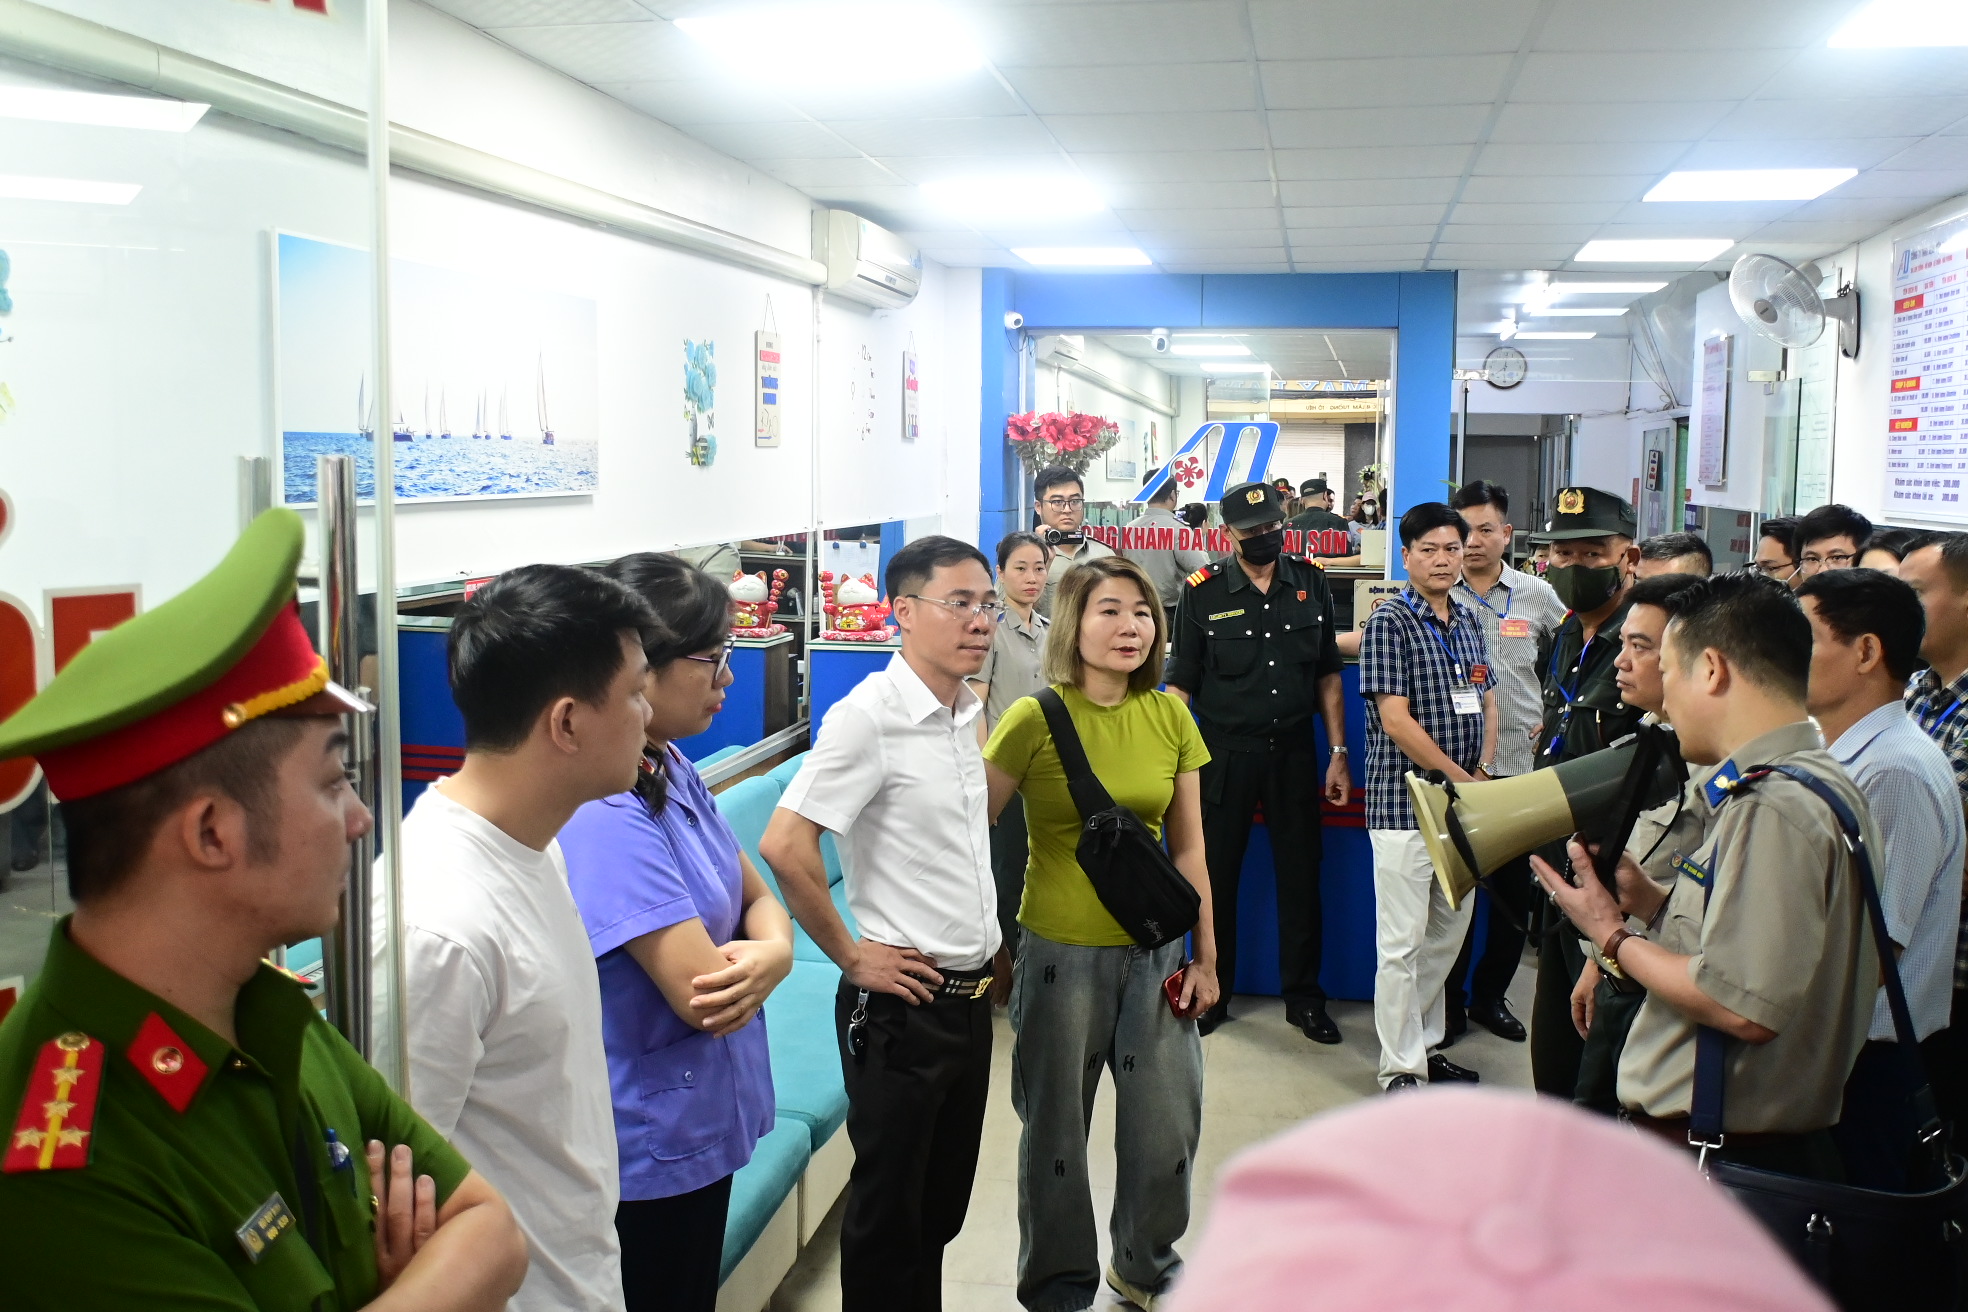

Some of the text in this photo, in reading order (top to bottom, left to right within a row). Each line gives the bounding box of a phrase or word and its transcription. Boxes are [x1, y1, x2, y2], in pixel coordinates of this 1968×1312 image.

[1122, 522, 1175, 550] KHÁM
[1179, 528, 1204, 551] ĐA
[1207, 528, 1232, 552] KH
[1307, 528, 1348, 554] SƠN
